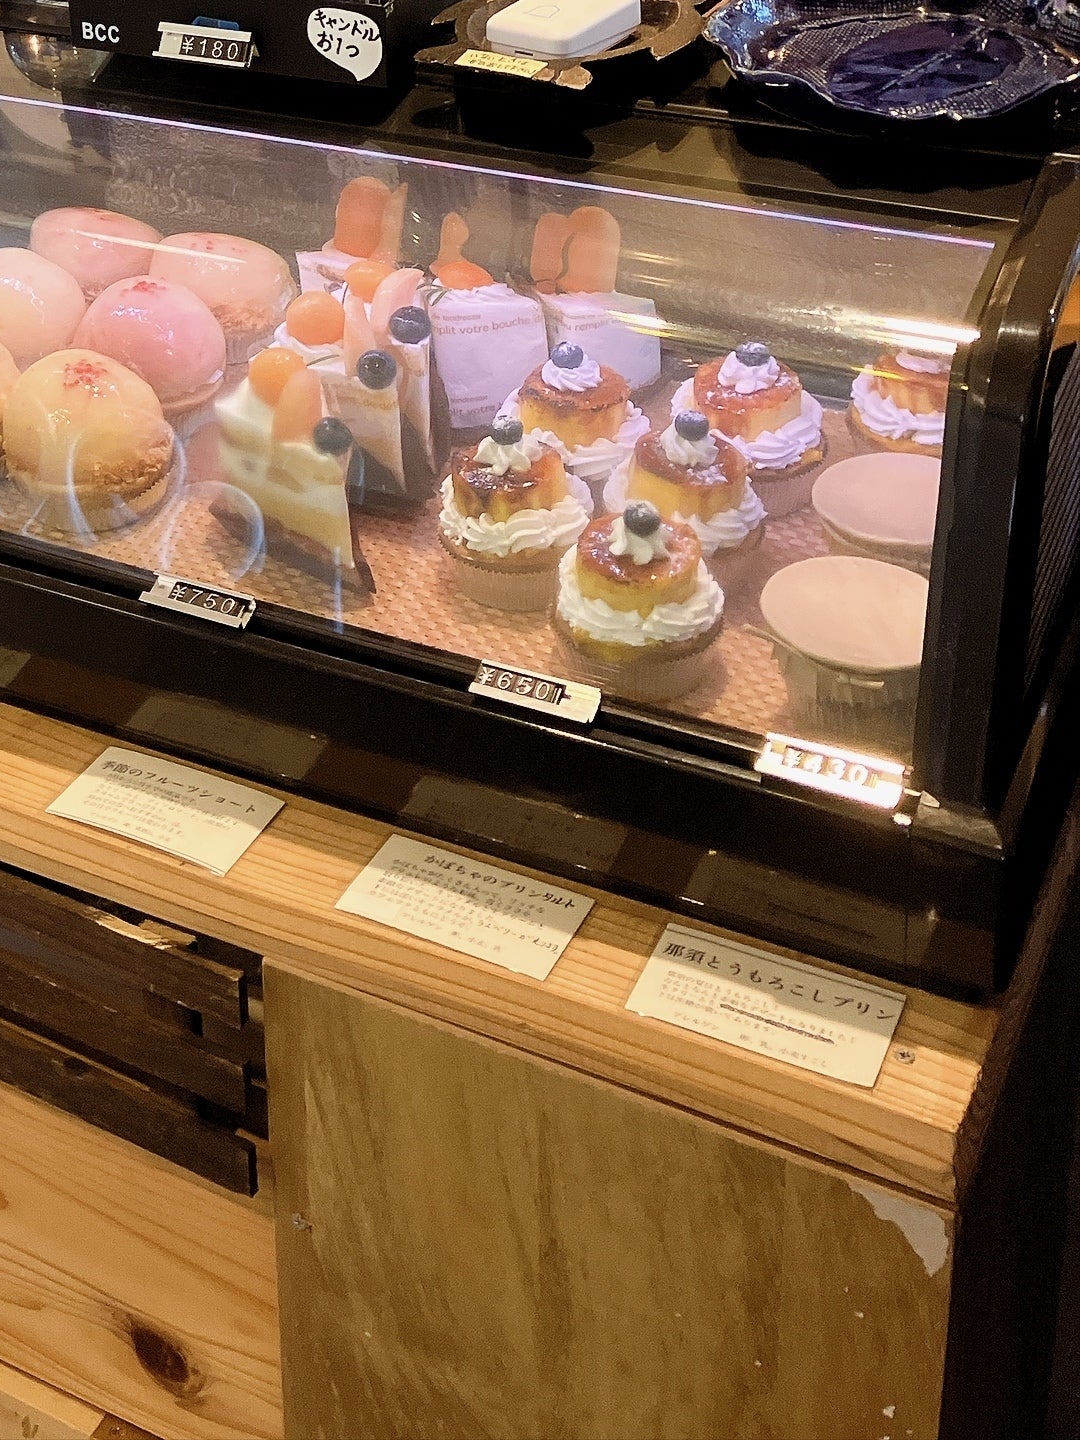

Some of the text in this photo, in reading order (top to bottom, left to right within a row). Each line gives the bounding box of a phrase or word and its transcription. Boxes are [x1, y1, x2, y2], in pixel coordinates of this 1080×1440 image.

[82, 22, 120, 43] BCC
[314, 10, 380, 41] キャンドル
[182, 36, 240, 60] ¥180
[460, 325, 489, 335] votre
[171, 584, 236, 614] ¥750
[479, 665, 550, 700] ¥650
[101, 760, 256, 814] 季節のフルーツショート
[423, 854, 575, 909] かぼちゃのプリンタルト
[663, 941, 896, 1020] 那須とうもろこしプリン
